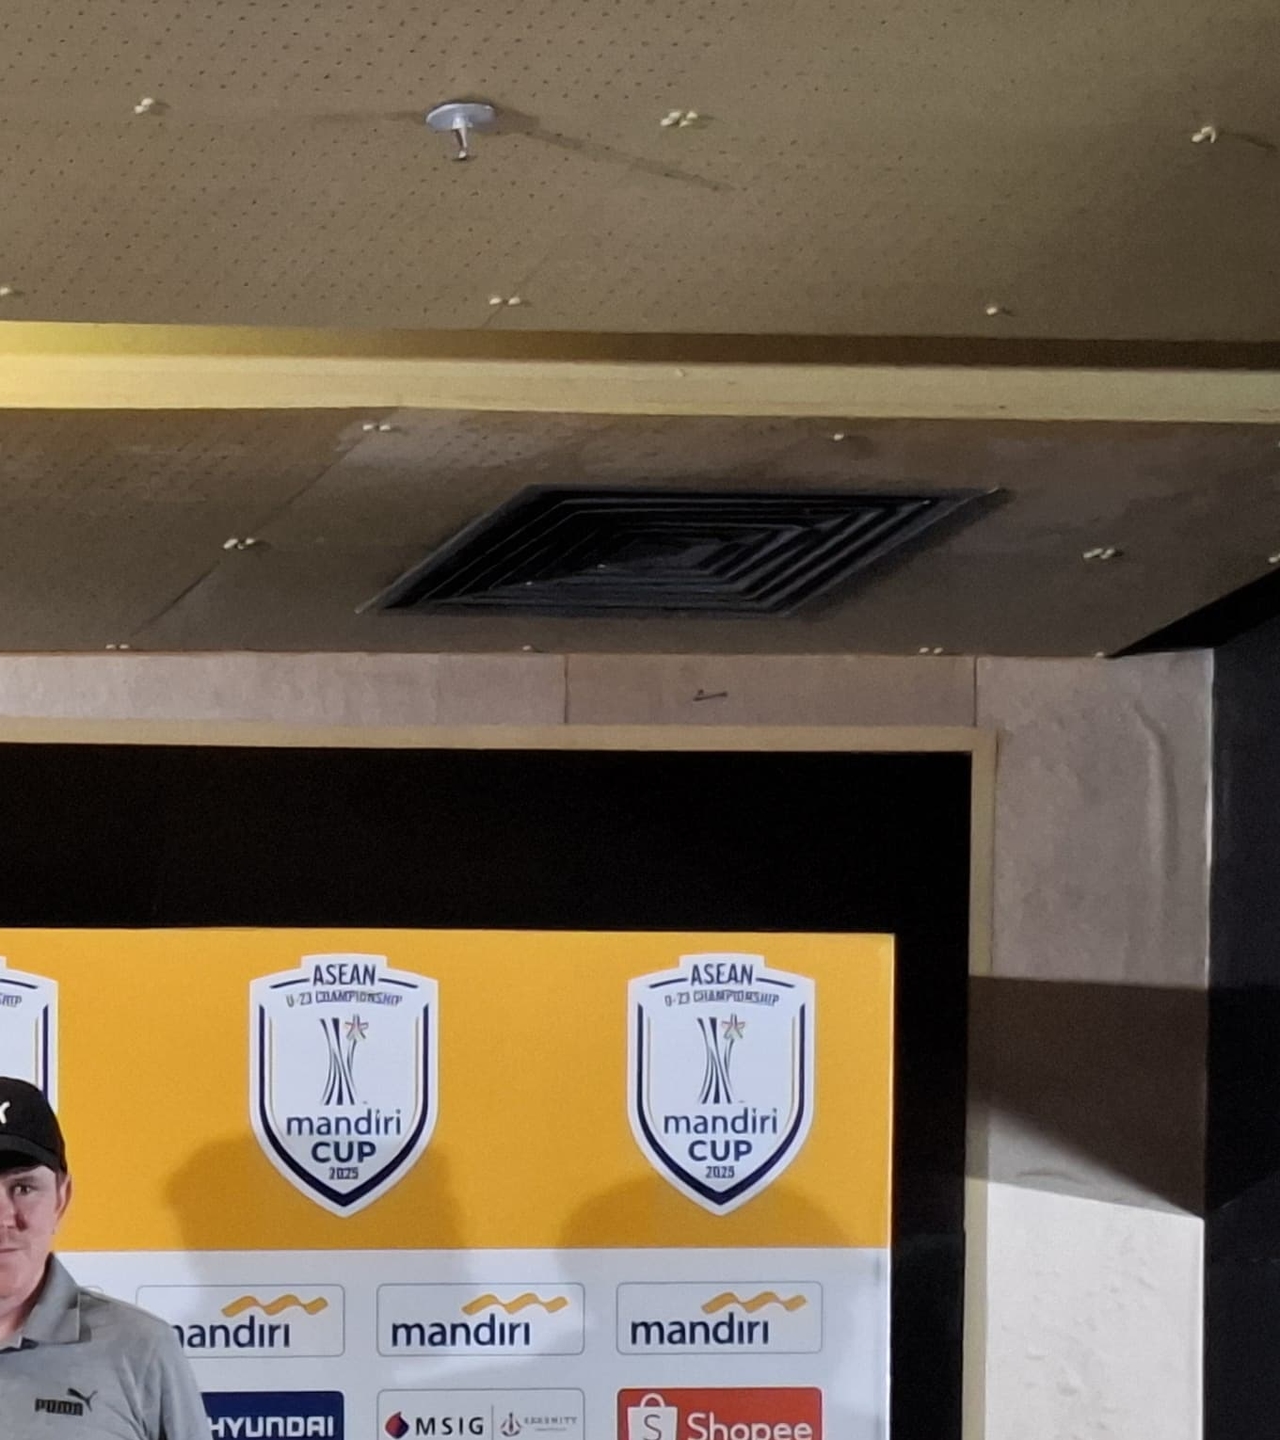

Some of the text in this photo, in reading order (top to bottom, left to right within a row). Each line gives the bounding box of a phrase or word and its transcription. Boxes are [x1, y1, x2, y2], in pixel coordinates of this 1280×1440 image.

[313, 964, 375, 985] ASEAN
[691, 963, 753, 985] ASEAN
[287, 1109, 400, 1136] mandiri
[664, 1108, 776, 1134] mandiri
[312, 1142, 376, 1163] CUP
[688, 1141, 752, 1161] CUP
[392, 1314, 529, 1346] mandiri
[631, 1312, 768, 1344] mandiri
[209, 1416, 334, 1438] HYUNDAI
[416, 1417, 483, 1435] MSIG
